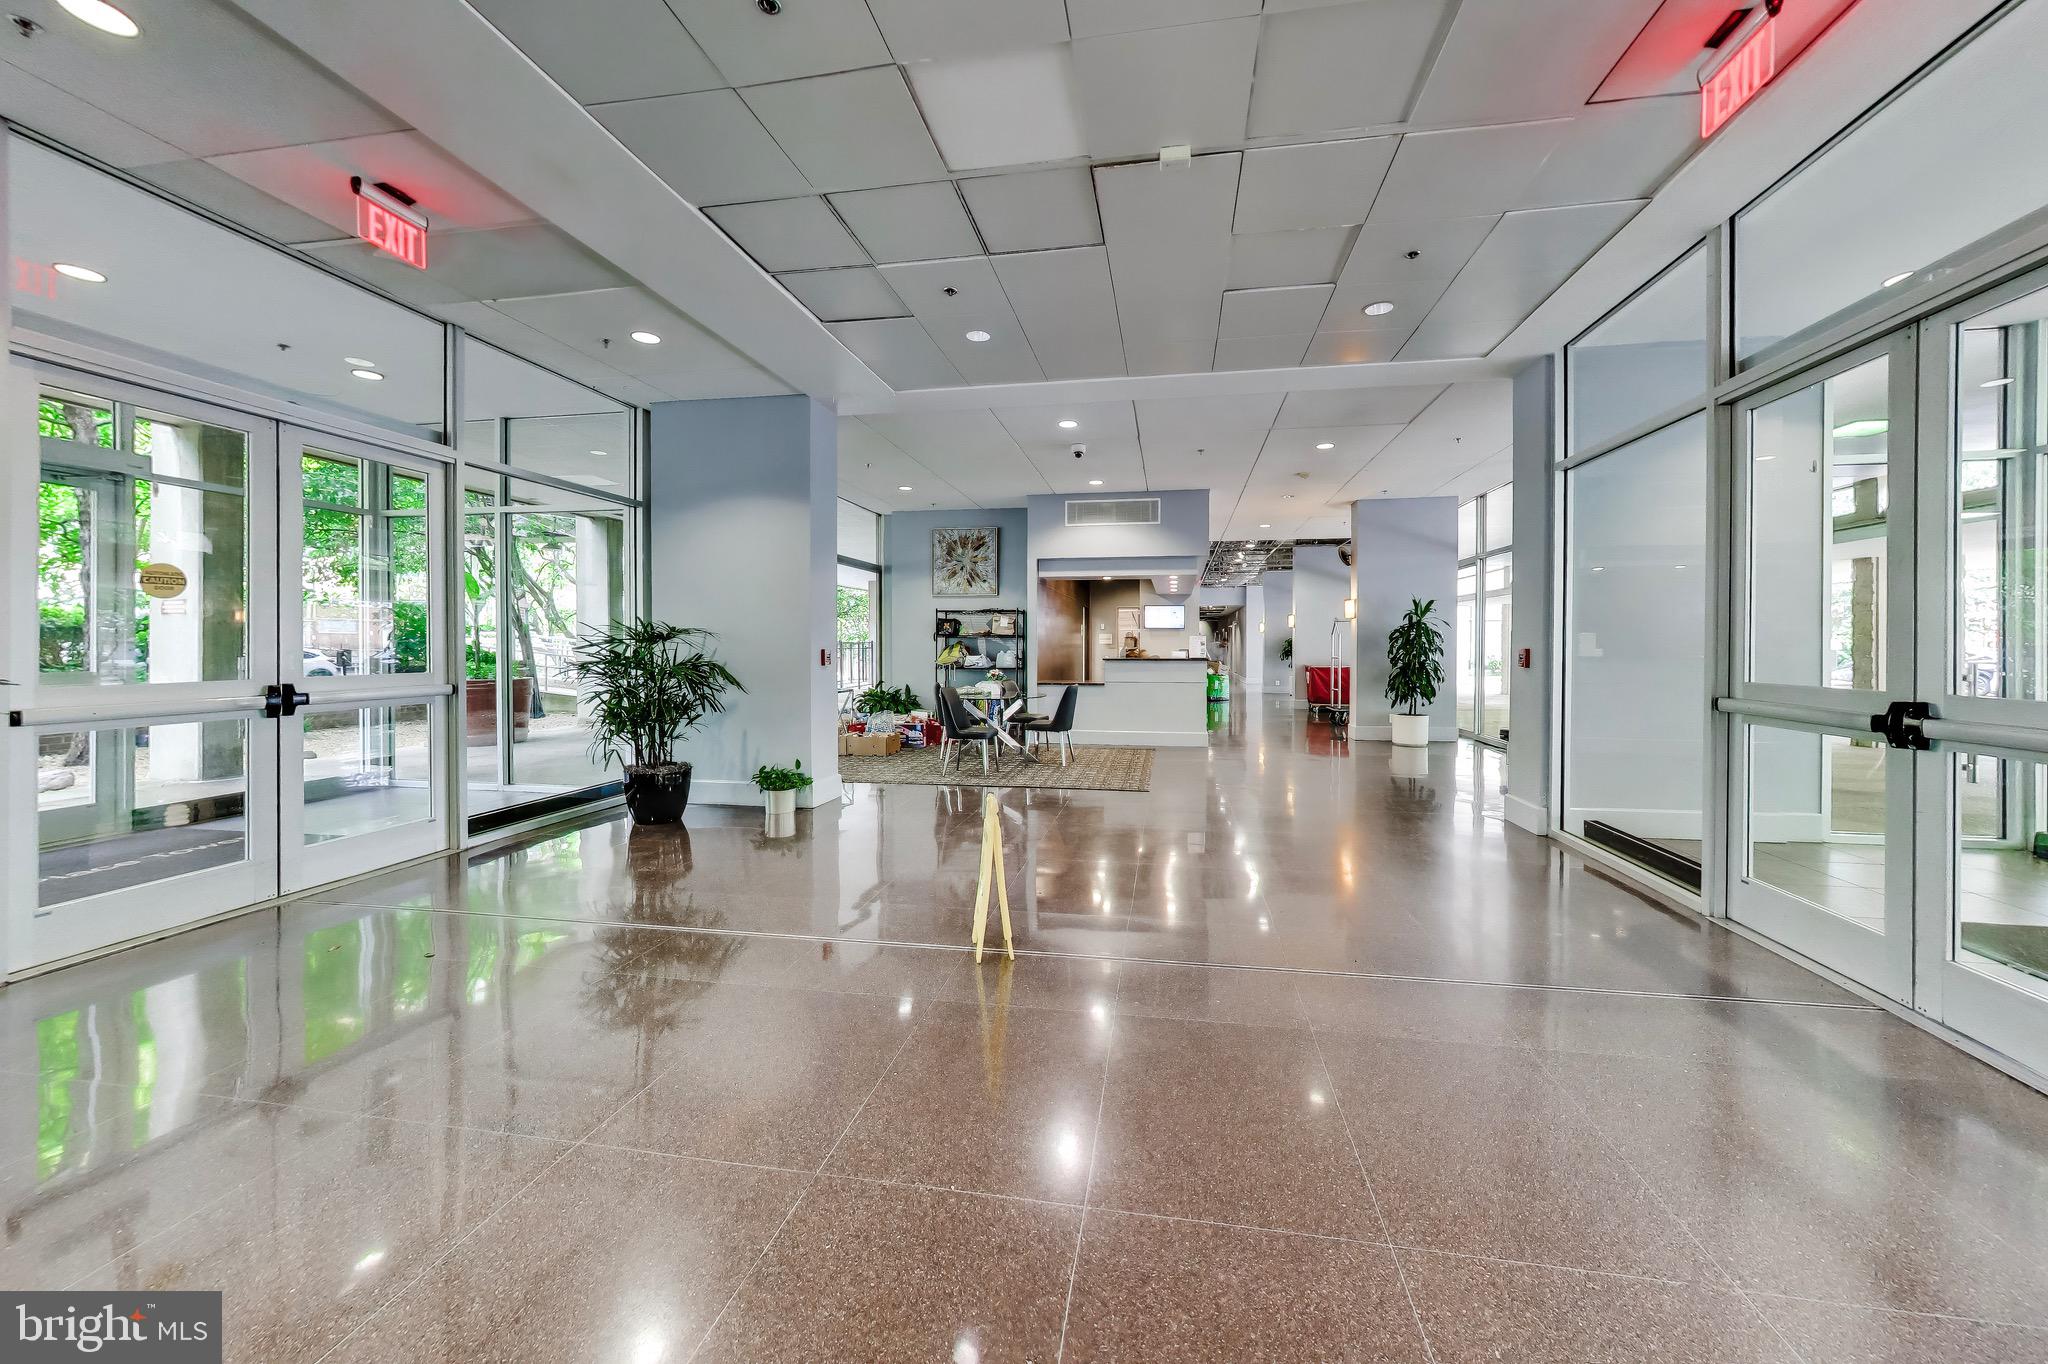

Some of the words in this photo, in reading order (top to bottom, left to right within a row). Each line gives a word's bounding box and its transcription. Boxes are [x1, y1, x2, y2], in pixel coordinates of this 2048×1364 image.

[1714, 23, 1766, 128] EXIT
[368, 203, 418, 263] EXIT
[143, 576, 185, 585] CAUTION
